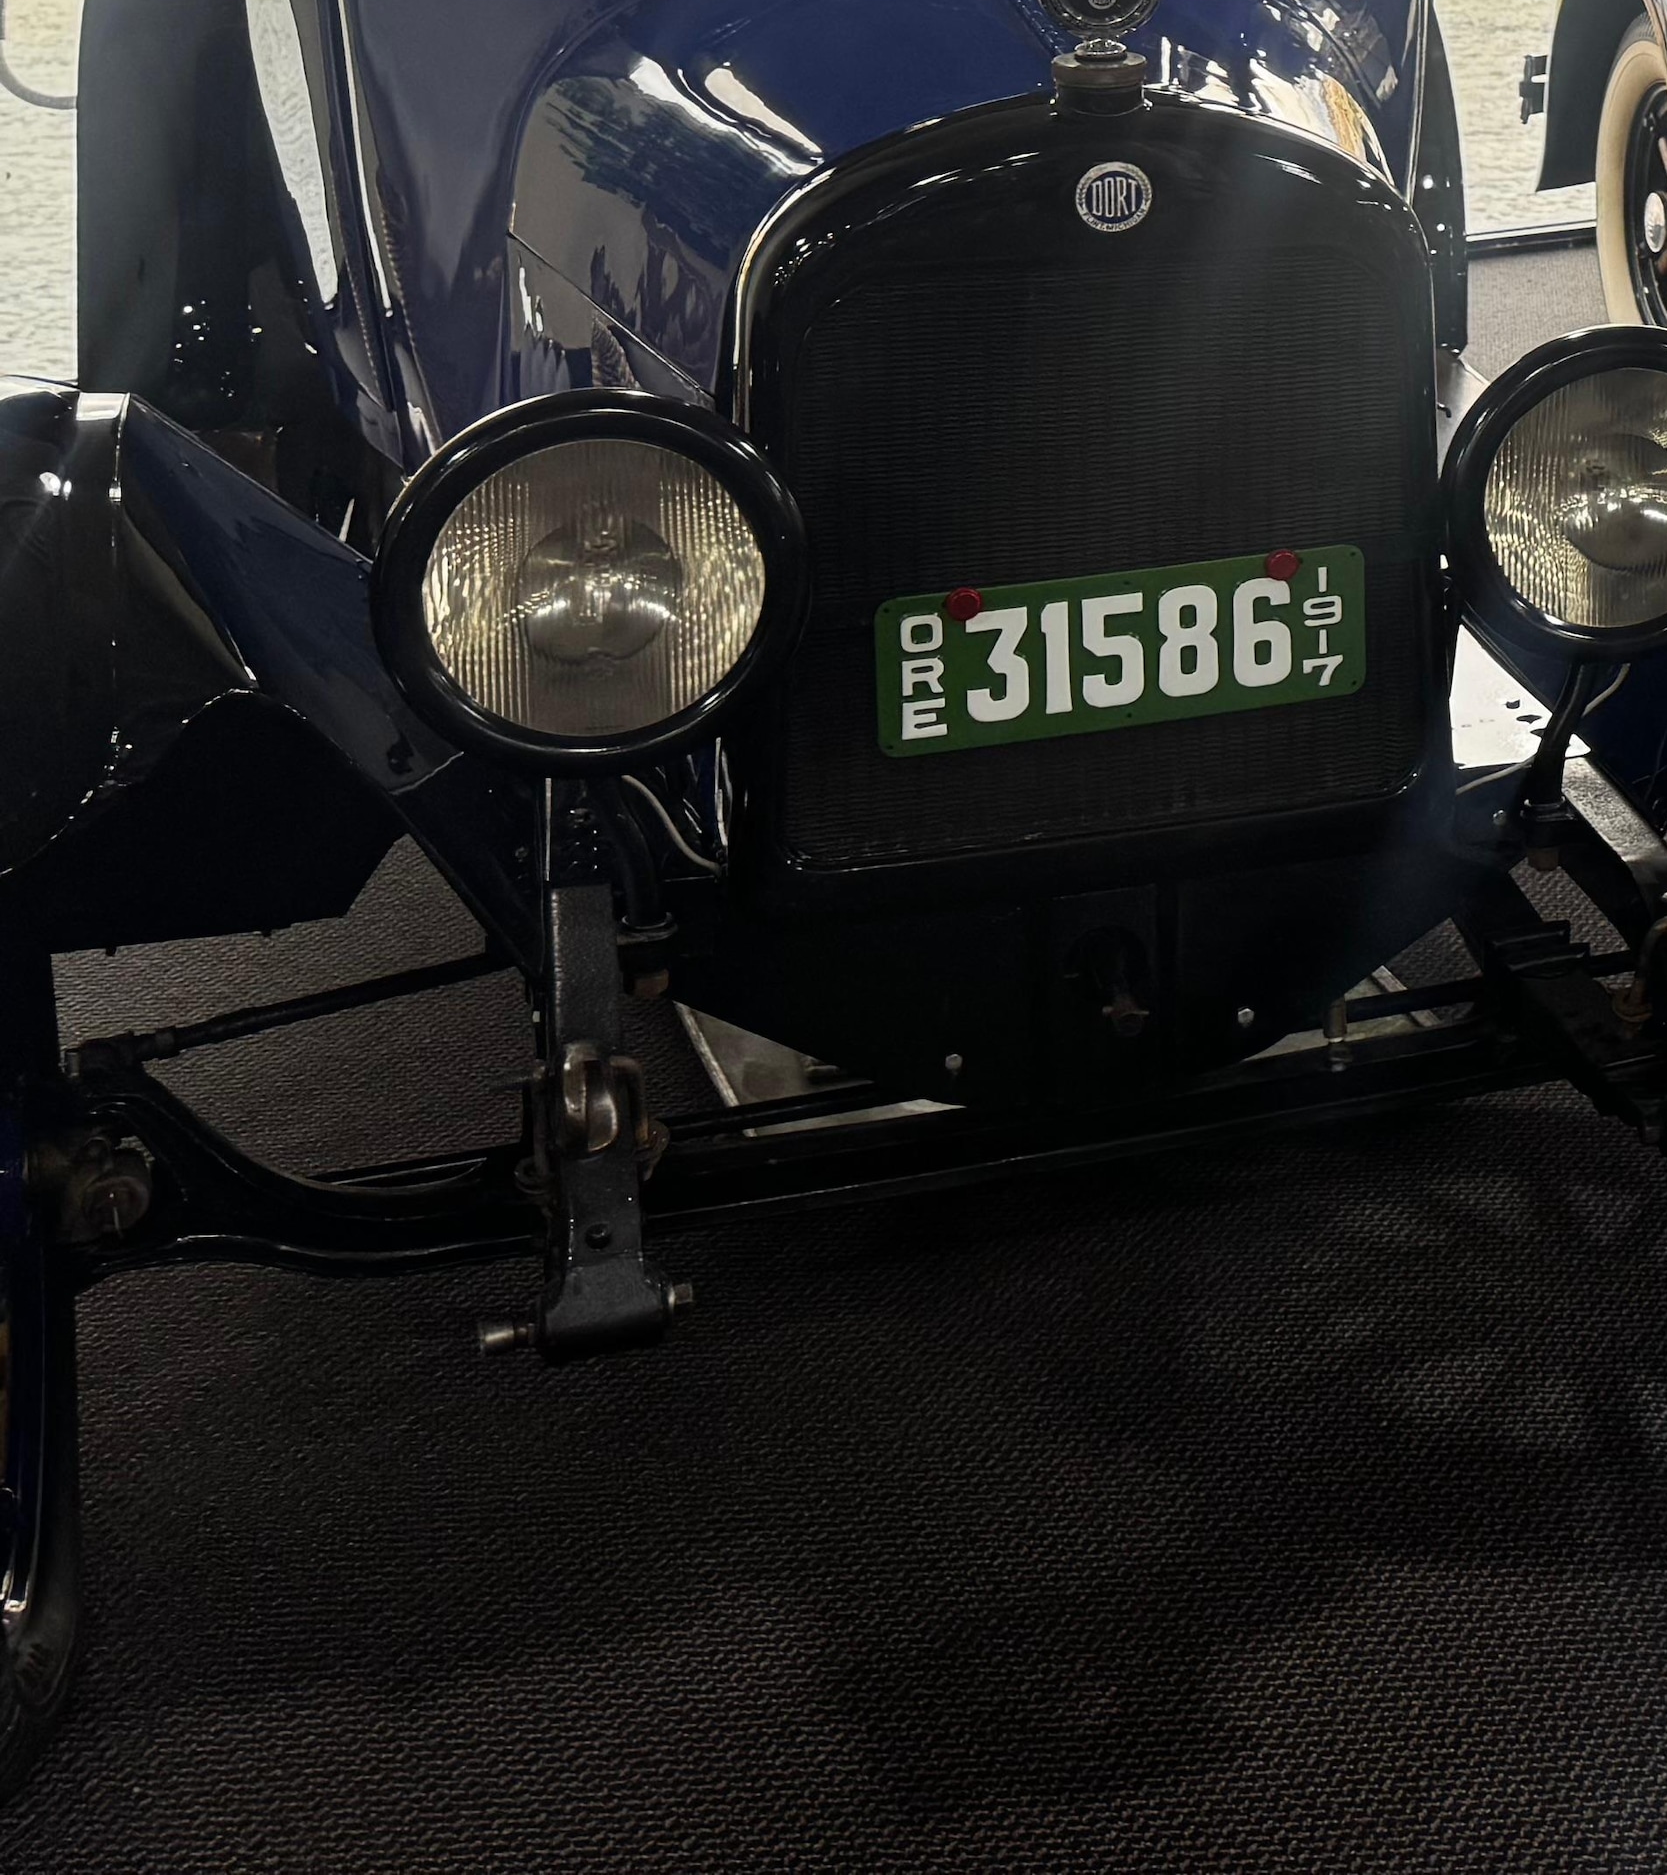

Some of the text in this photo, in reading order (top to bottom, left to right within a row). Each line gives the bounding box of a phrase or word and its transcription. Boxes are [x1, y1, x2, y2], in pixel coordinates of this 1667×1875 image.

[1091, 175, 1139, 218] DORT
[900, 612, 948, 741] ORE
[965, 577, 1293, 723] 31586
[1302, 565, 1344, 687] 1917
